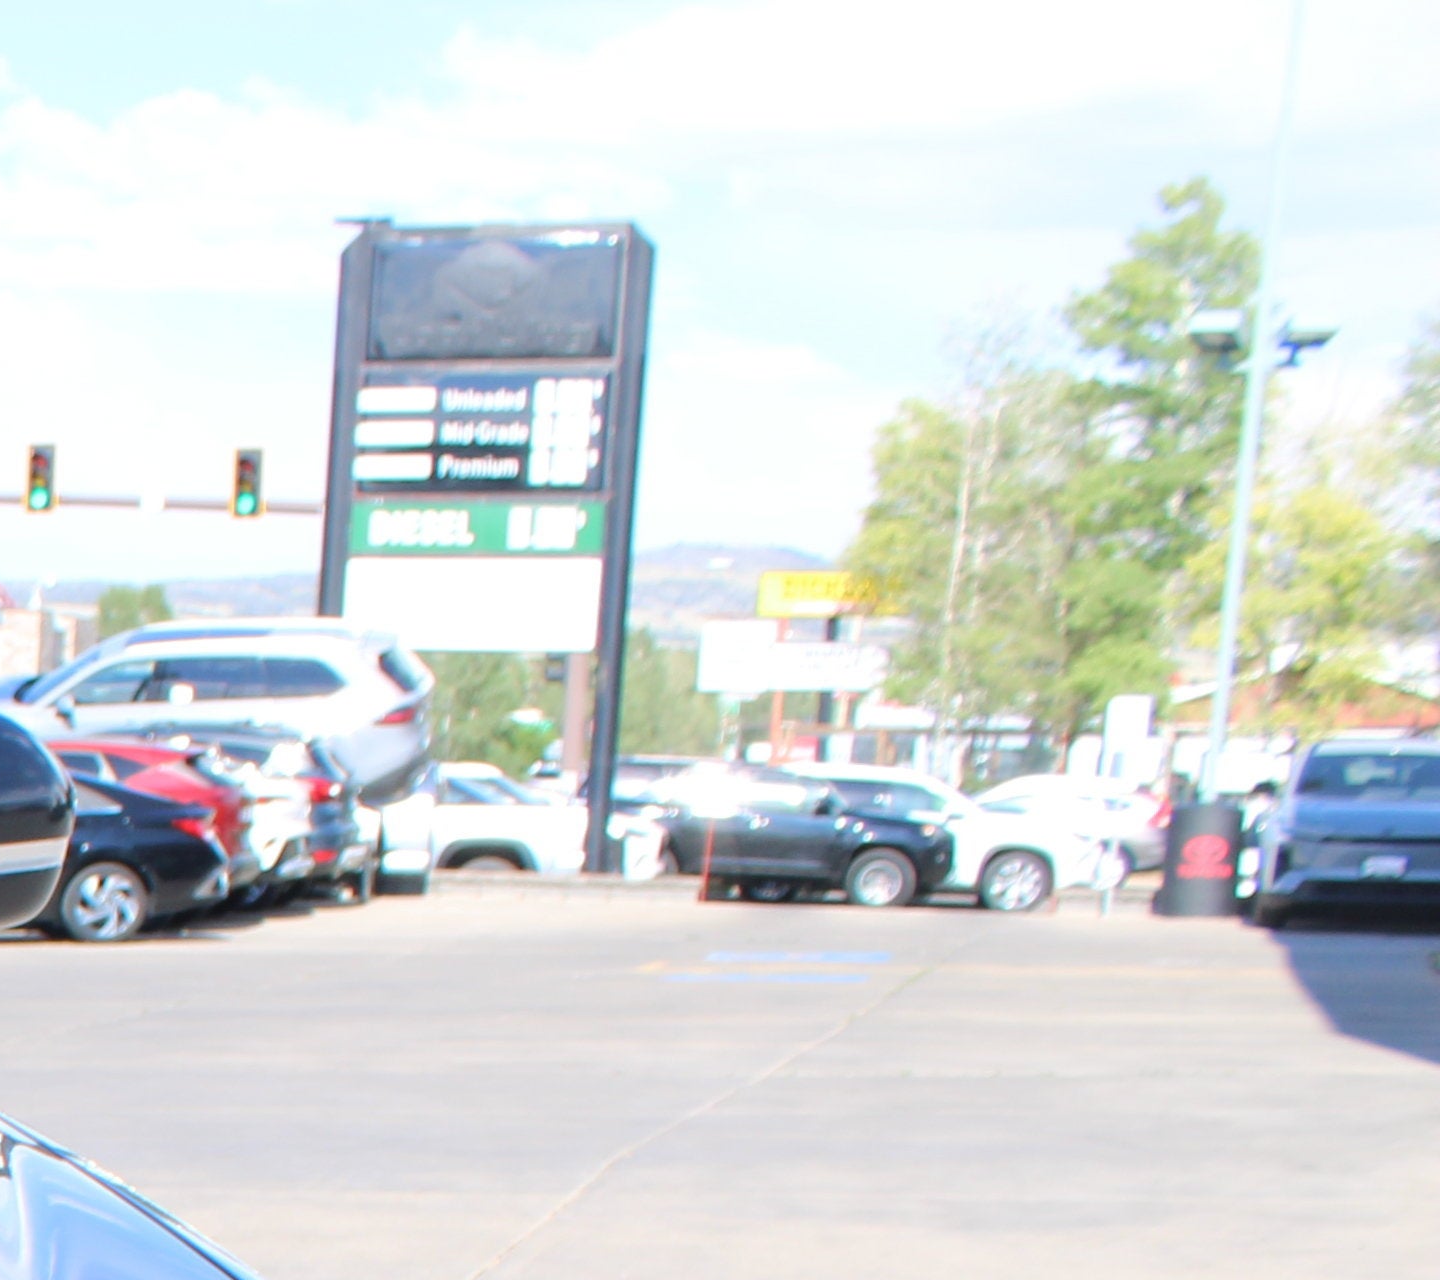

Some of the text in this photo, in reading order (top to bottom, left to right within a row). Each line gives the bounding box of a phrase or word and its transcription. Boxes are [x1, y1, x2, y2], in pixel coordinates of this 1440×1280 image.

[442, 387, 527, 413] Unleaded
[436, 453, 519, 480] Premium
[368, 509, 475, 547] DIESEL
